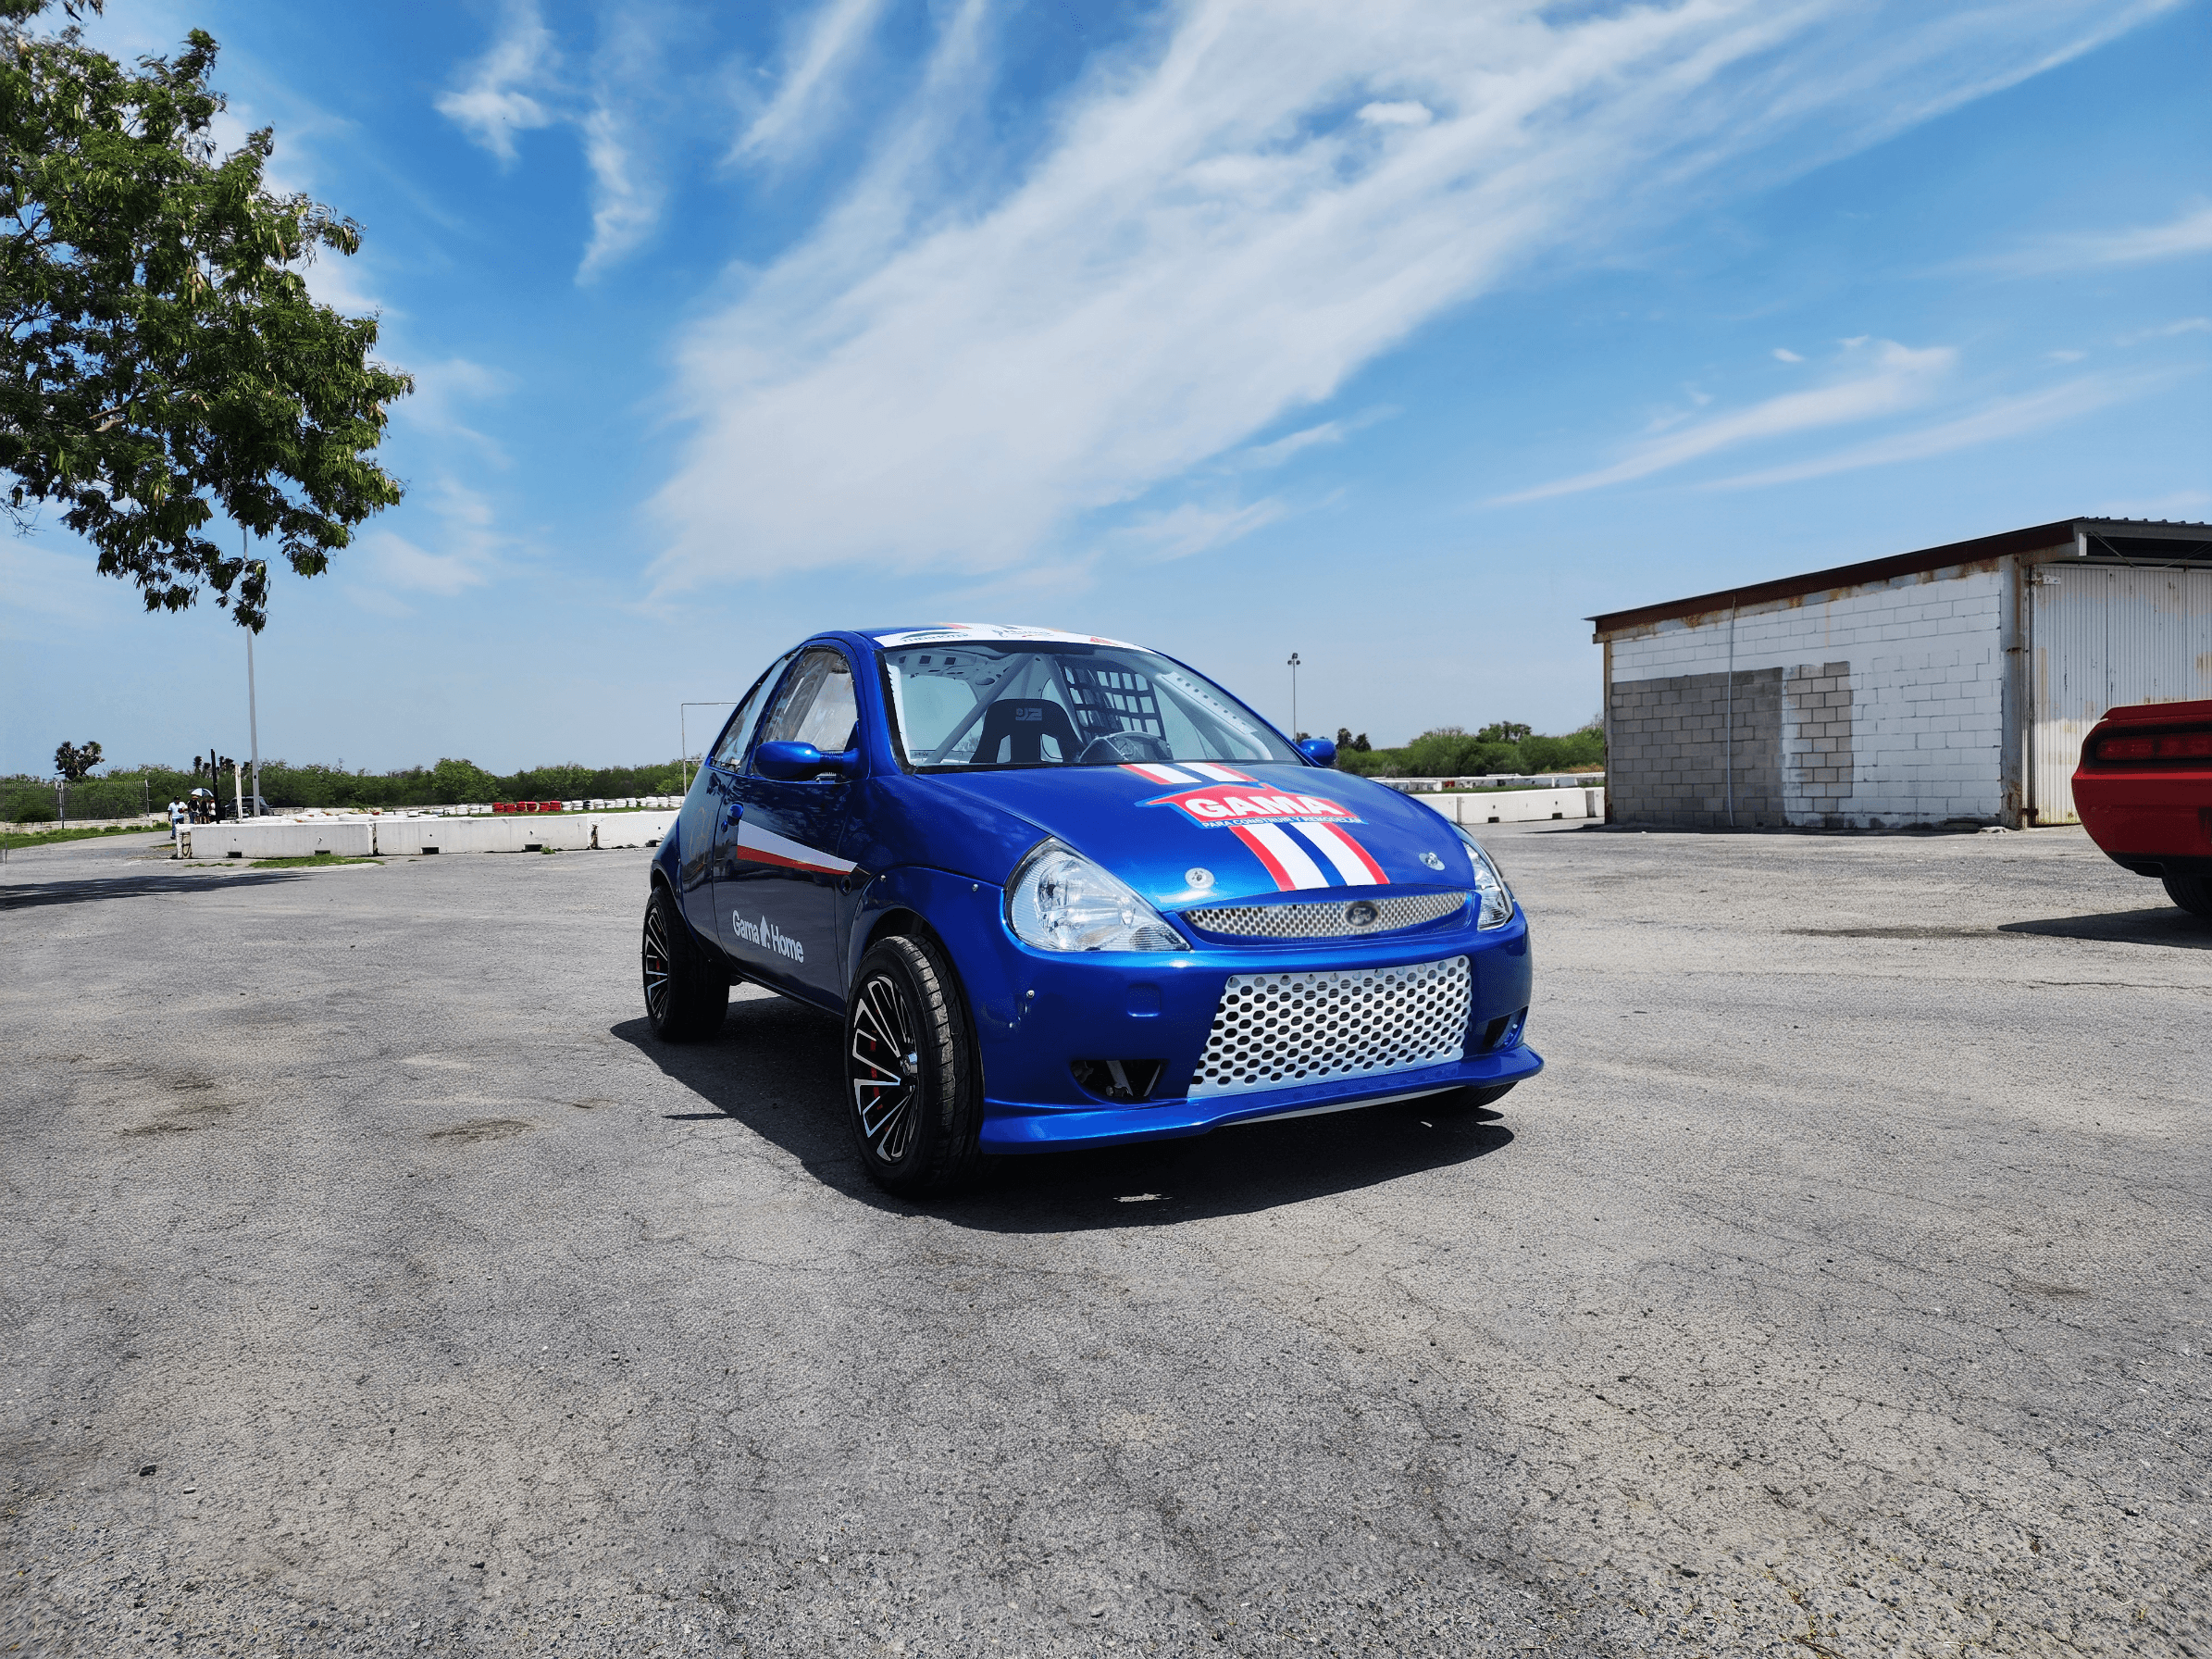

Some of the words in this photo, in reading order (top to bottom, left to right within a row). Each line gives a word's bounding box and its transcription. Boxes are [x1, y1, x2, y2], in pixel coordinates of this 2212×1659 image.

[1186, 796, 1346, 817] GAMA
[1203, 819, 1233, 828] PARA
[1233, 817, 1291, 825] CONSTRUIR
[733, 910, 760, 944] Gama
[771, 924, 803, 964] Home
